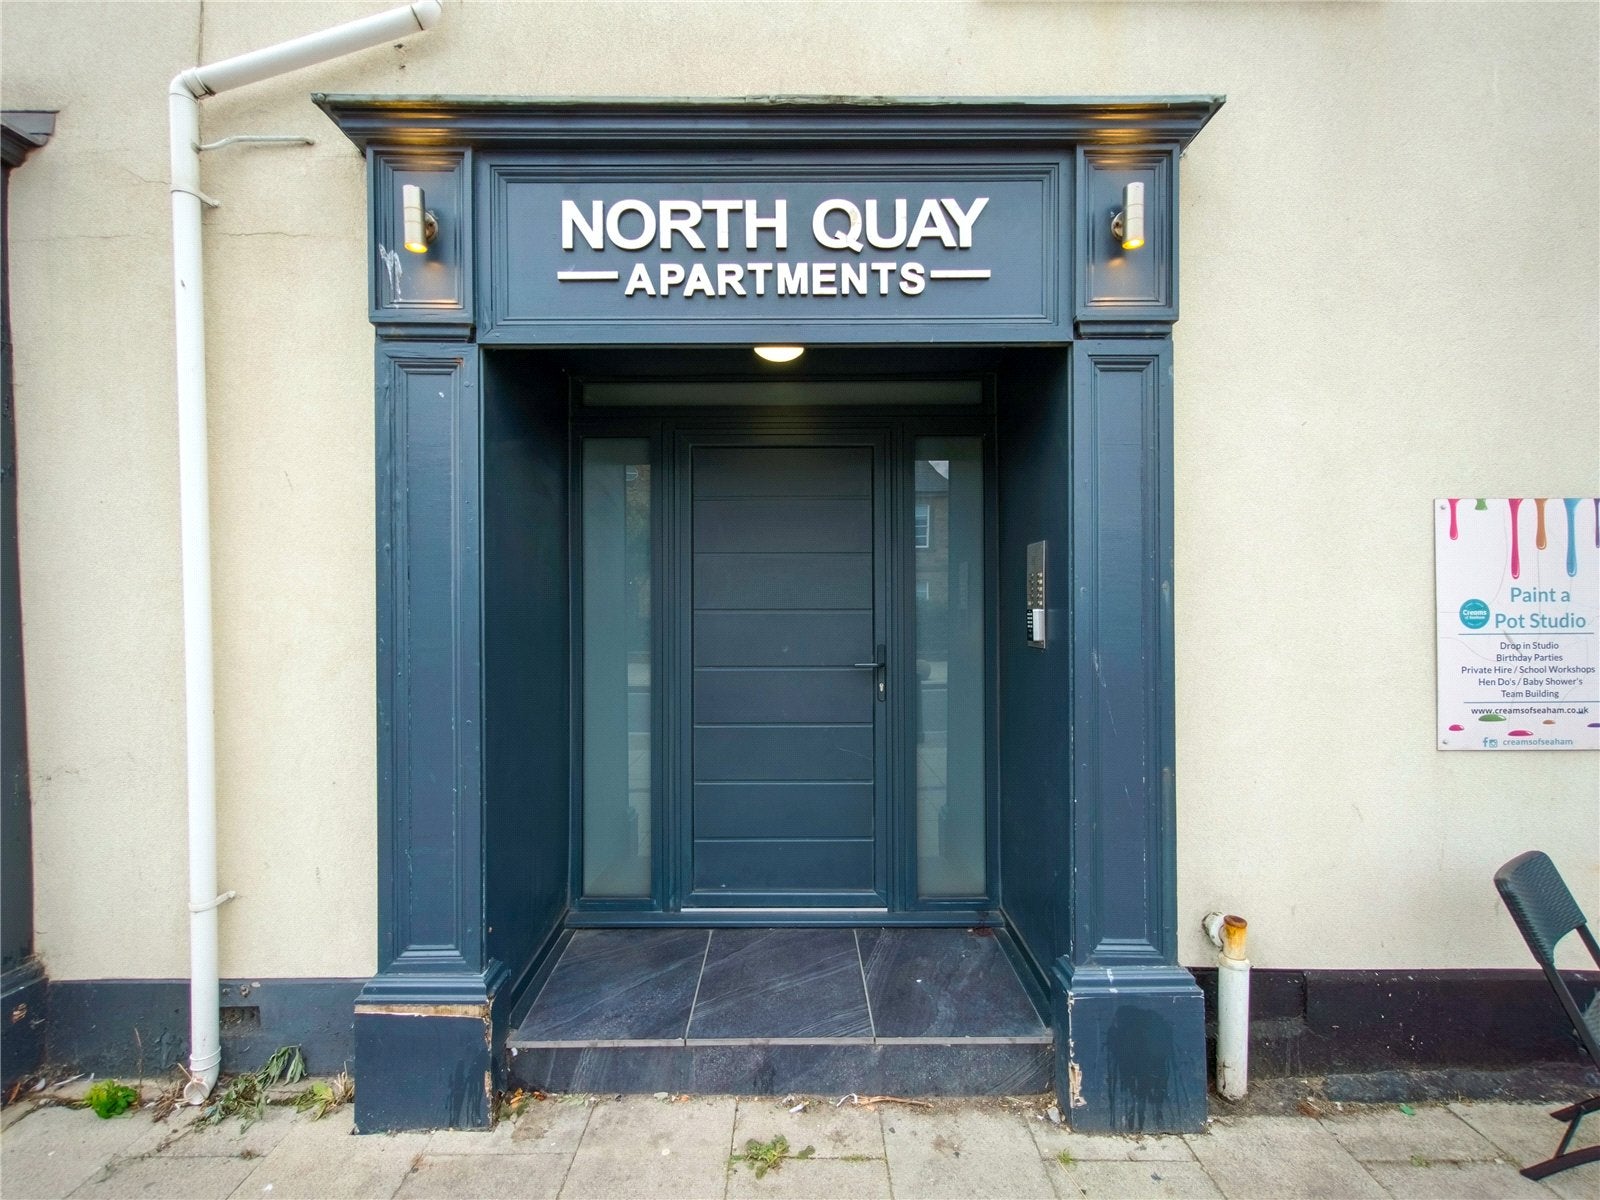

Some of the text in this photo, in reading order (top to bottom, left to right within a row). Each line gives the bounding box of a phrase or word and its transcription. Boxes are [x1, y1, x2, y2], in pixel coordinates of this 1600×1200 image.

[561, 197, 990, 253] NORTH QUAY
[624, 262, 926, 297] APARTMENTS
[1510, 587, 1571, 602] Paint a
[1495, 612, 1587, 628] Pot Studio
[1500, 641, 1559, 651] Drop in Studio
[1496, 653, 1563, 663] Birthday Parties
[1461, 666, 1492, 674] Private
[1494, 666, 1512, 674] Hire
[1548, 665, 1596, 674] Workshops
[1478, 678, 1496, 686] Hen
[1498, 678, 1516, 686] Do's
[1523, 678, 1543, 687] Baby
[1546, 677, 1583, 686] Shower's
[1501, 690, 1559, 699] Team Building
[1471, 706, 1589, 715] www.creamsofseaham.co.uk
[1503, 738, 1573, 746] creamsofseaham
